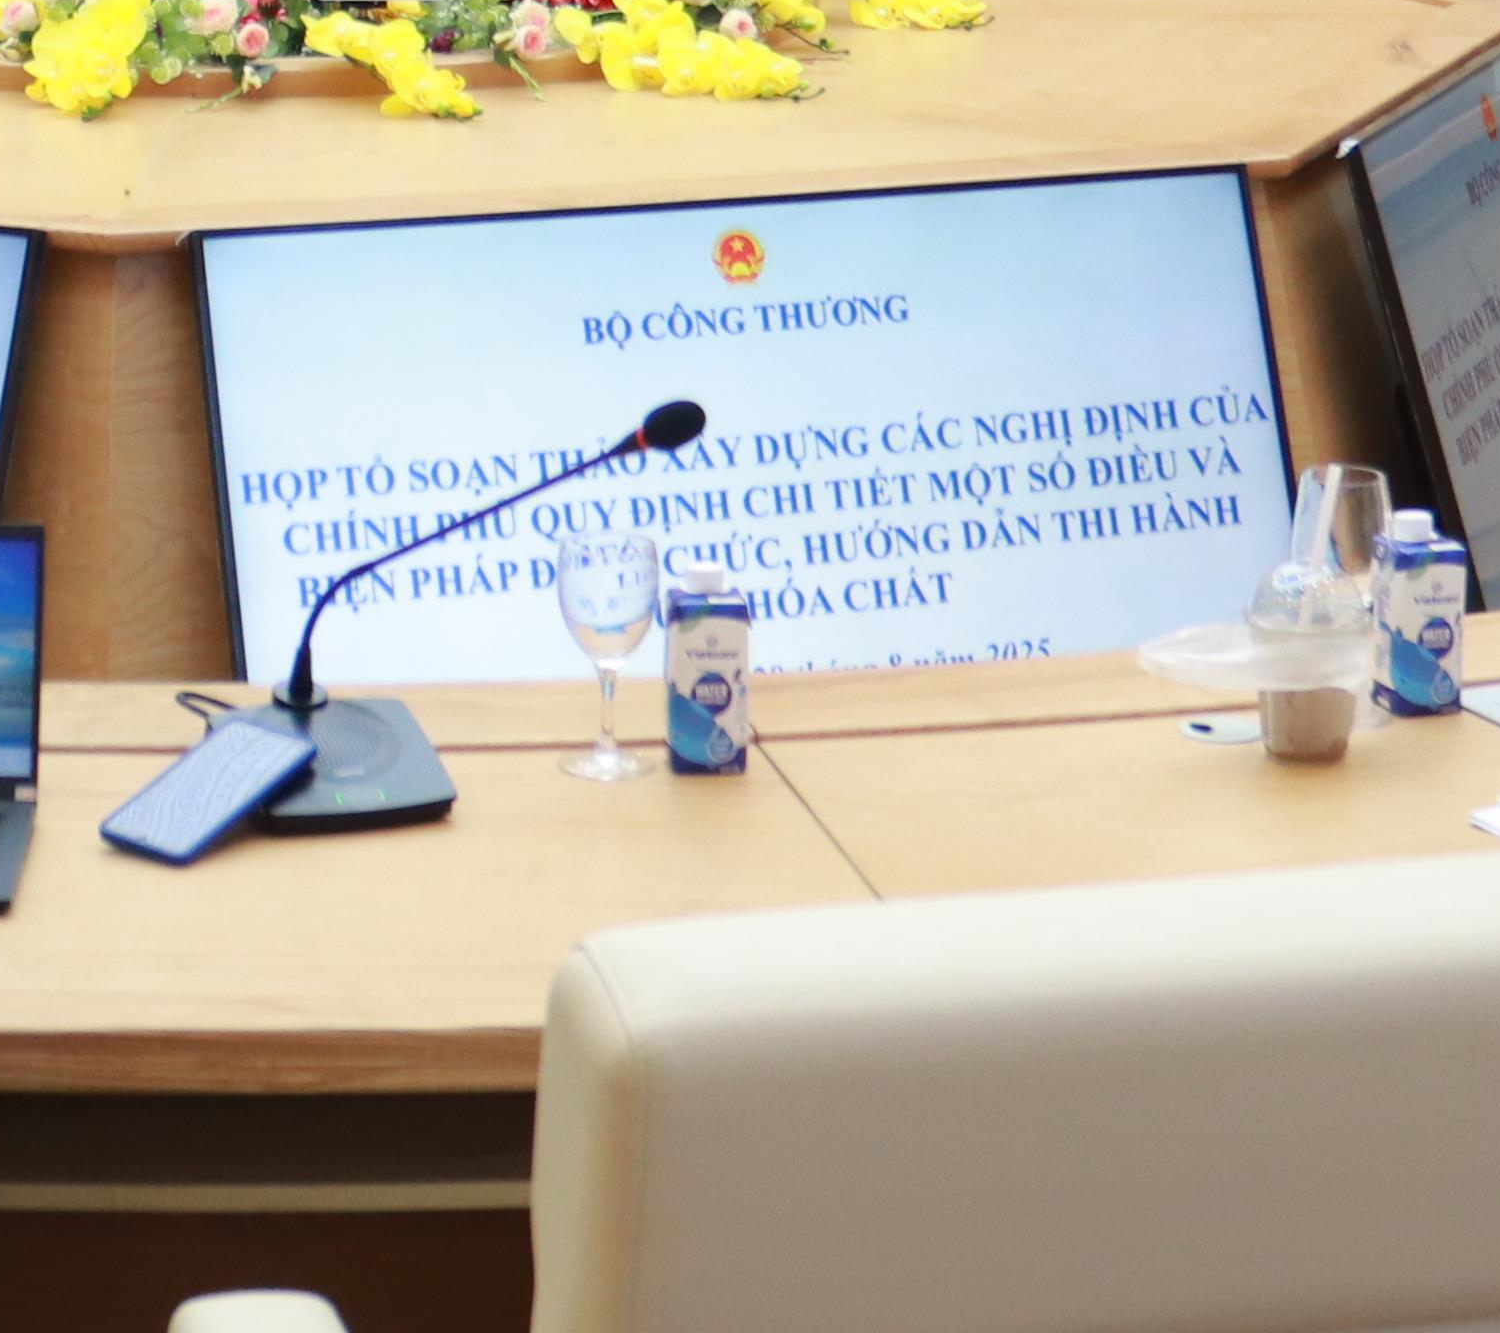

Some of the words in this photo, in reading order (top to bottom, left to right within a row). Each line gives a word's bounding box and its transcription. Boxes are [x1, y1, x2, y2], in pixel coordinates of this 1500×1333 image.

[581, 309, 633, 349] BỘ
[642, 299, 747, 342] CÔNG
[752, 291, 910, 335] THƯƠNG
[241, 464, 329, 510] HỌP
[336, 455, 395, 499] TỔ
[407, 452, 518, 498] SOẠN
[755, 423, 869, 469] DỰNG
[880, 411, 963, 454] CÁC
[973, 408, 1073, 451] NGHỊ
[1083, 398, 1180, 442] ĐỊNH
[1189, 384, 1270, 429] CỦA
[283, 513, 420, 556] CHÍNH
[530, 499, 619, 541] QUY
[630, 488, 730, 533] ĐỊNH
[743, 483, 816, 520] CHI
[825, 465, 917, 511] TIẾT
[928, 463, 1018, 506] MỘT
[1028, 449, 1077, 494] SỐ
[1089, 446, 1179, 487] ĐIỀU
[1188, 436, 1243, 476] VÀ
[410, 557, 519, 600] PHÁP
[803, 523, 951, 567] HƯỚNG
[962, 511, 1041, 553] DẪN
[1051, 506, 1119, 544] THI
[1131, 493, 1243, 535] HÀNH
[747, 581, 835, 622] HÓA
[842, 571, 954, 613] CHẤT
